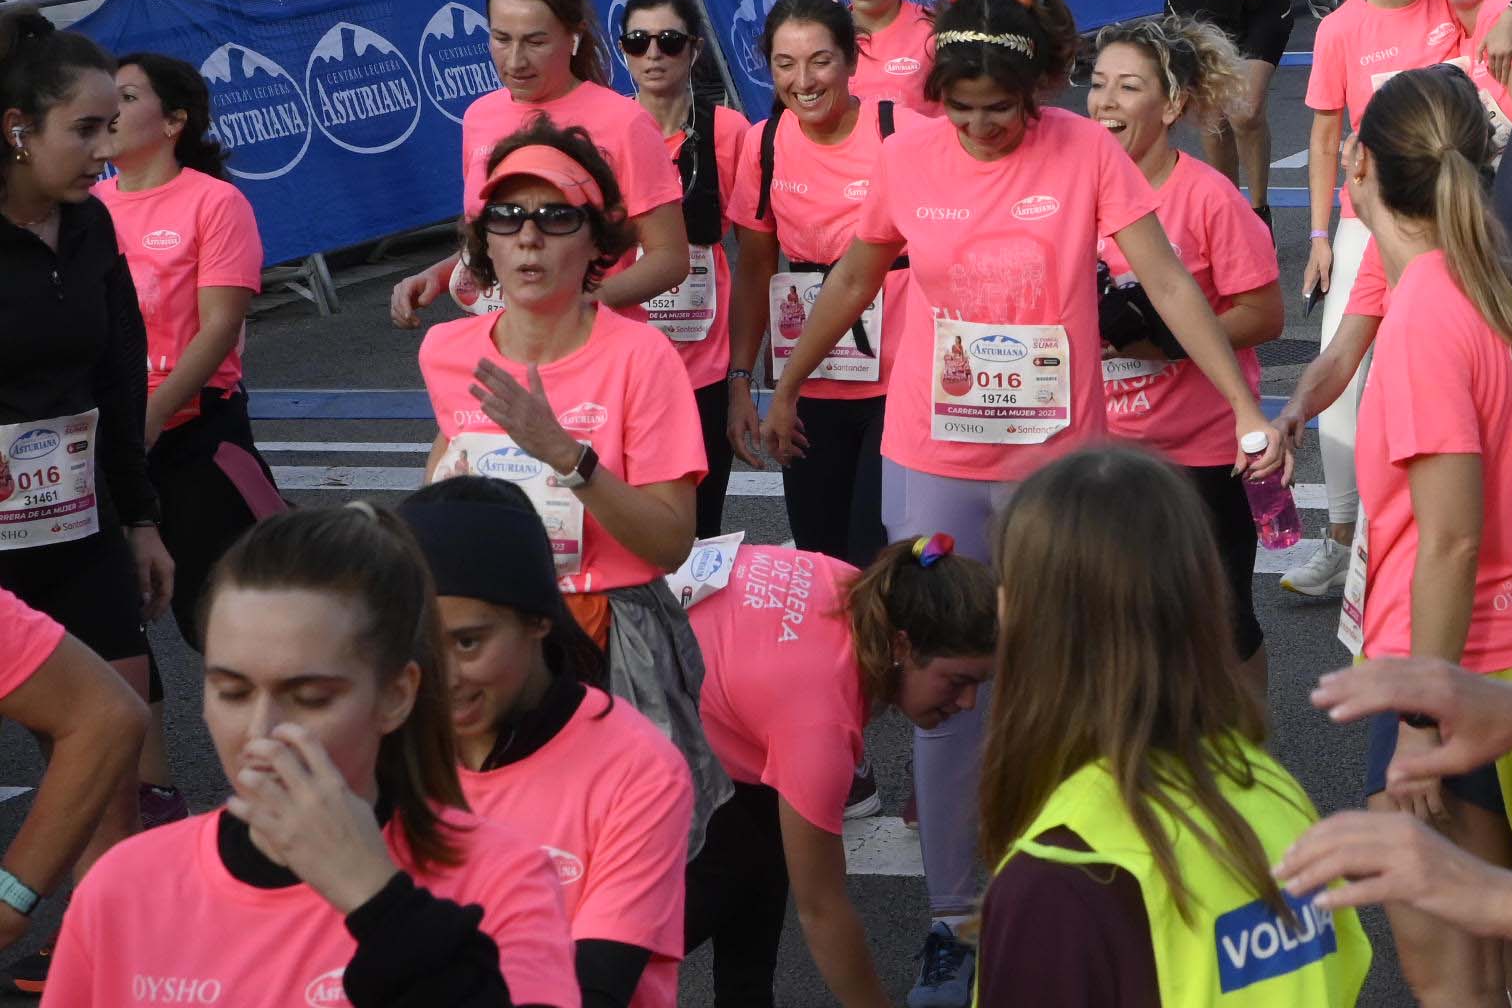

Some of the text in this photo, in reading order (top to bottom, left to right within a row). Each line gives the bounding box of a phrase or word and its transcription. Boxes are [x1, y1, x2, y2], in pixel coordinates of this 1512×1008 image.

[1360, 47, 1399, 65] OYSHO
[429, 53, 499, 102] ASTURIA
[316, 76, 416, 127] ASTURIANA
[207, 101, 305, 149] ASTURIANA
[916, 206, 970, 220] OYSHO
[832, 349, 849, 357] UJER
[973, 344, 1024, 357] ASTURIANA
[833, 363, 869, 373] Santander
[1106, 360, 1142, 373] OYSHO
[977, 371, 1022, 389] 016
[981, 393, 1017, 404] 19746
[948, 406, 983, 416] CARRERA
[984, 408, 995, 416] DE
[1008, 409, 1036, 417] MUJER
[944, 423, 984, 433] OYSHO
[14, 438, 57, 454] ASTURIANA
[482, 458, 538, 474] ASTURIANA
[18, 466, 61, 490] 016
[24, 490, 58, 506] 31461
[0, 513, 26, 522] RRERA
[743, 552, 769, 610] MUJER
[763, 559, 793, 609] DE LA
[777, 556, 814, 642] CARRERA
